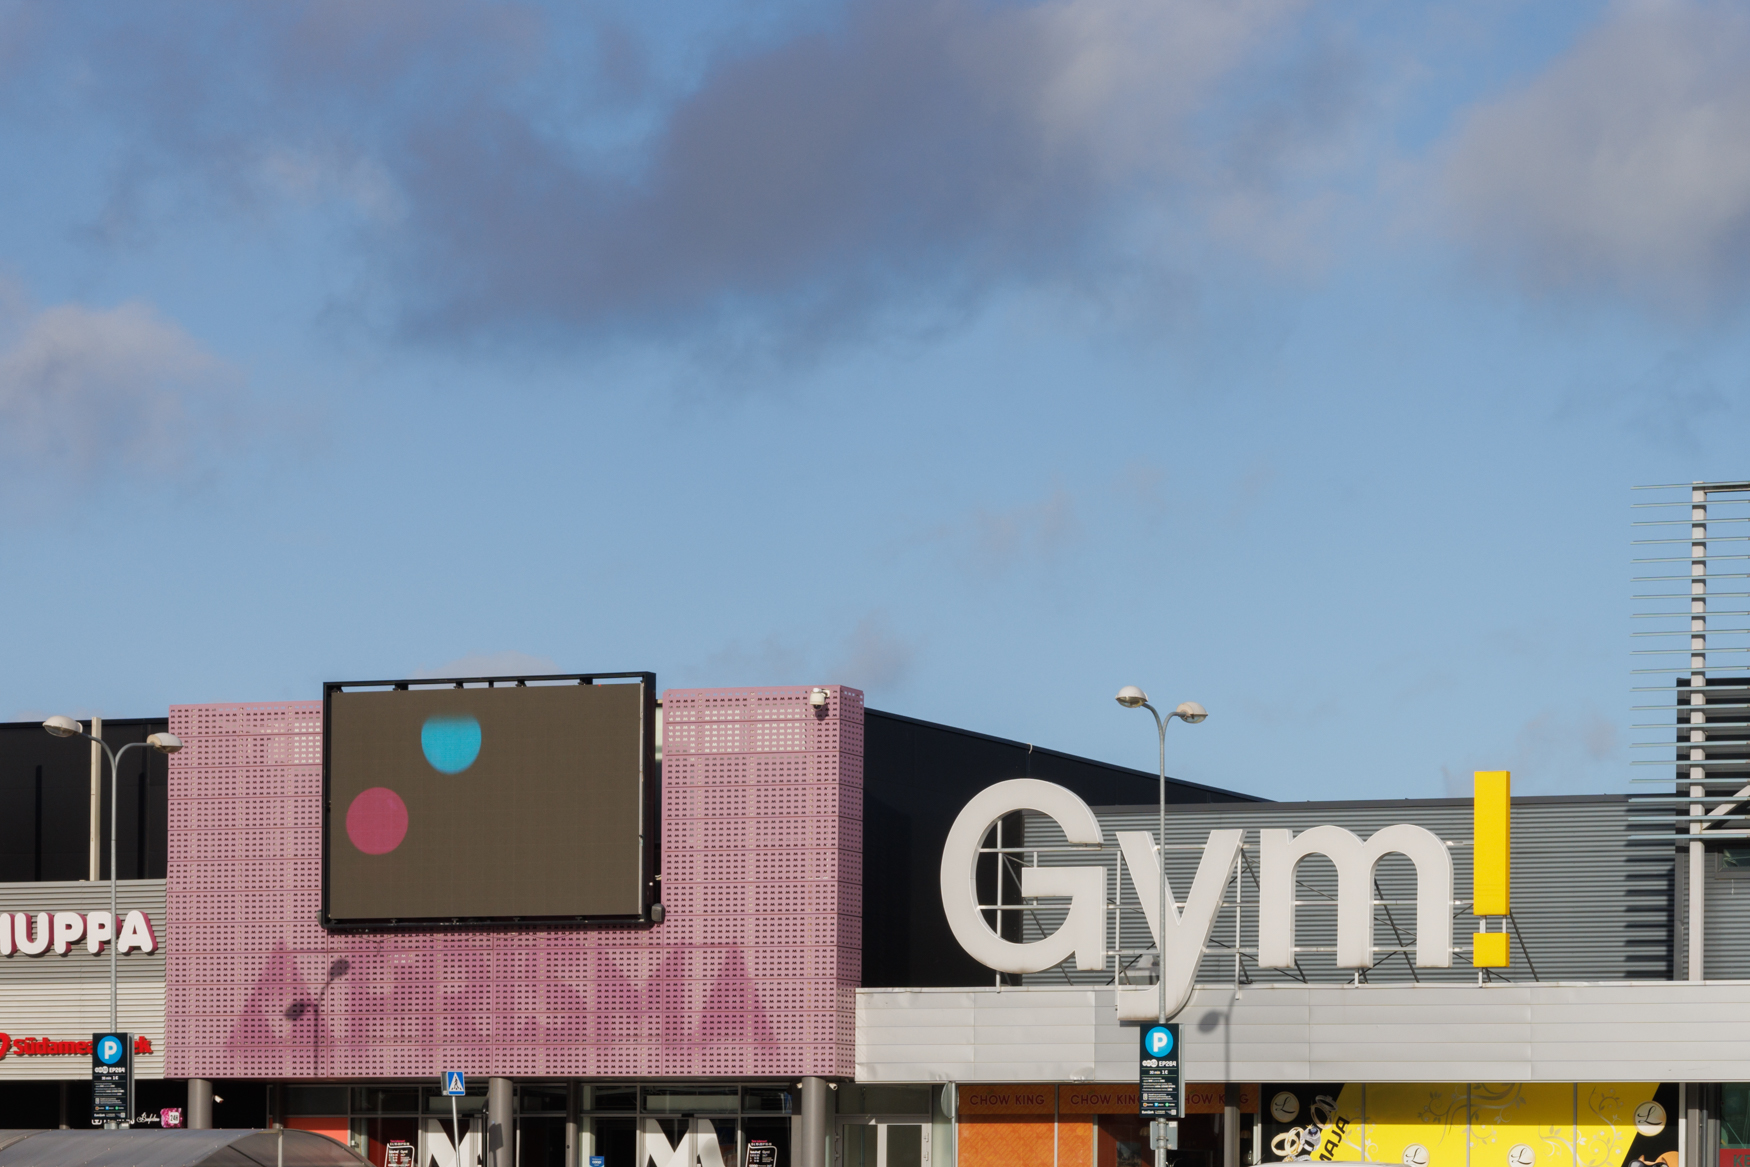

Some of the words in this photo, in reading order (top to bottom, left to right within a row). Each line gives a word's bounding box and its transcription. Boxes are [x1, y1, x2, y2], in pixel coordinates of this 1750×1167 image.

[941, 770, 1511, 1022] Gym!
[1153, 1032, 1168, 1052] P
[104, 1041, 117, 1059] P
[969, 1094, 1010, 1105] CHOW
[1015, 1094, 1045, 1105] KING
[1070, 1094, 1112, 1105] CHOW
[1118, 1094, 1140, 1105] KIN
[1185, 1094, 1213, 1105] HOW
